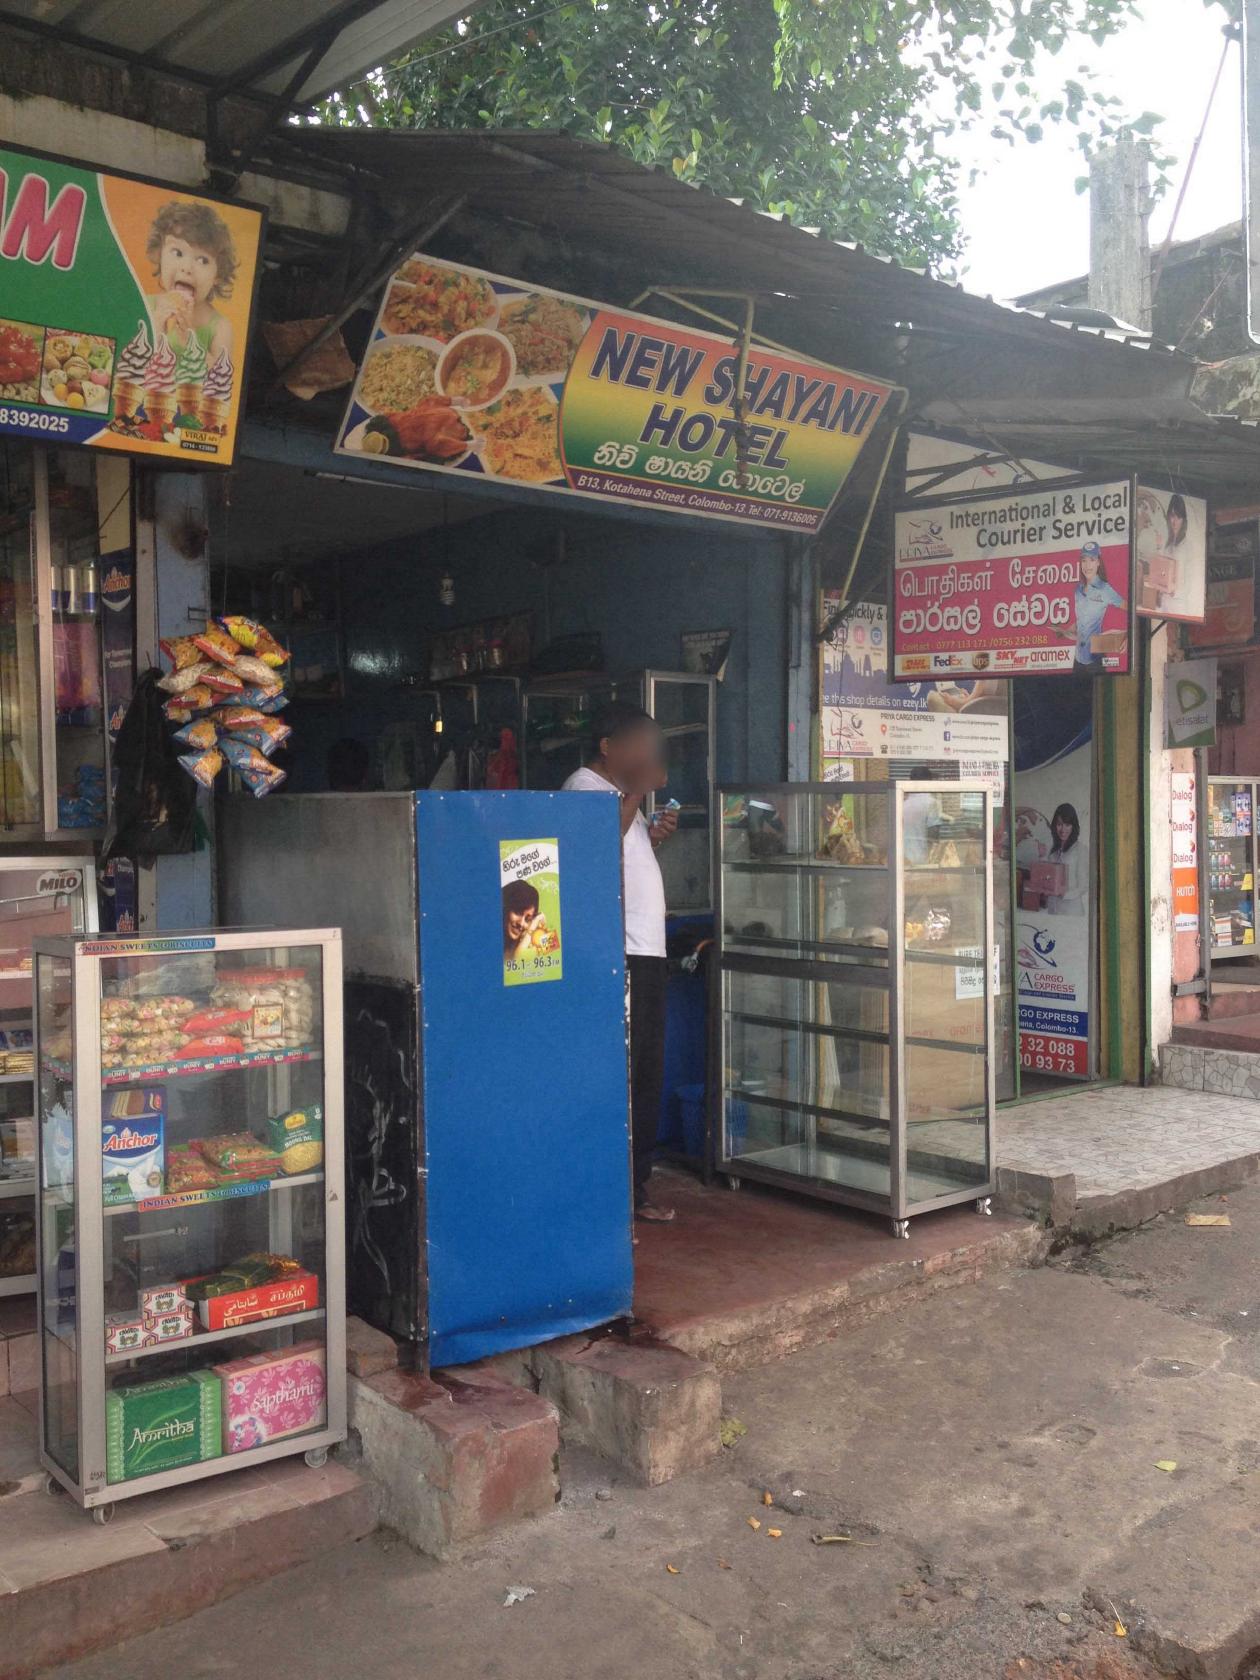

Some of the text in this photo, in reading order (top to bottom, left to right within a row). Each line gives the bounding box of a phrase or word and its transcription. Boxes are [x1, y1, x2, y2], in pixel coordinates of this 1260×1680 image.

[0, 168, 87, 271] M
[589, 326, 881, 437] NEW SHAYANI
[0, 408, 69, 432] 8392025
[637, 402, 790, 470] HOTEL
[578, 475, 600, 490] B13,
[603, 480, 652, 497] Kotahena
[748, 505, 763, 515] Tel:
[764, 508, 819, 525] 071-9136005
[950, 487, 1128, 529] International & Local
[976, 513, 1126, 548] Courier Service
[900, 558, 1080, 602] பொதிகள் சேவை
[900, 593, 1070, 634] පාර්සල් සේවය
[934, 655, 963, 667] FedEx
[1030, 649, 1070, 662] aramex
[832, 692, 845, 703] this
[846, 695, 864, 706] shop
[866, 695, 891, 705] details
[903, 695, 928, 711] ezey.lk
[881, 713, 935, 722] PRIYA CARGO EXPRESS
[1176, 713, 1208, 726] etisalat
[1172, 790, 1193, 802] Dialog
[1172, 821, 1193, 833] Dialog
[1173, 852, 1194, 865] Dialog
[39, 877, 78, 892] MILO
[119, 943, 158, 951] SWEETS
[506, 959, 525, 972] 96.1
[1034, 973, 1064, 983] CARGO
[1034, 981, 1075, 993] EXPRESS
[1018, 1008, 1079, 1023] GO EXPRESS
[1028, 1037, 1045, 1052] 32
[1049, 1041, 1075, 1057] 088
[1036, 1055, 1053, 1069] 93
[1058, 1058, 1075, 1073] 73
[103, 1132, 158, 1152] Anchor
[143, 1197, 177, 1208] INDIAN
[180, 1191, 215, 1202] SWEETS
[128, 1418, 194, 1451] Amritha
